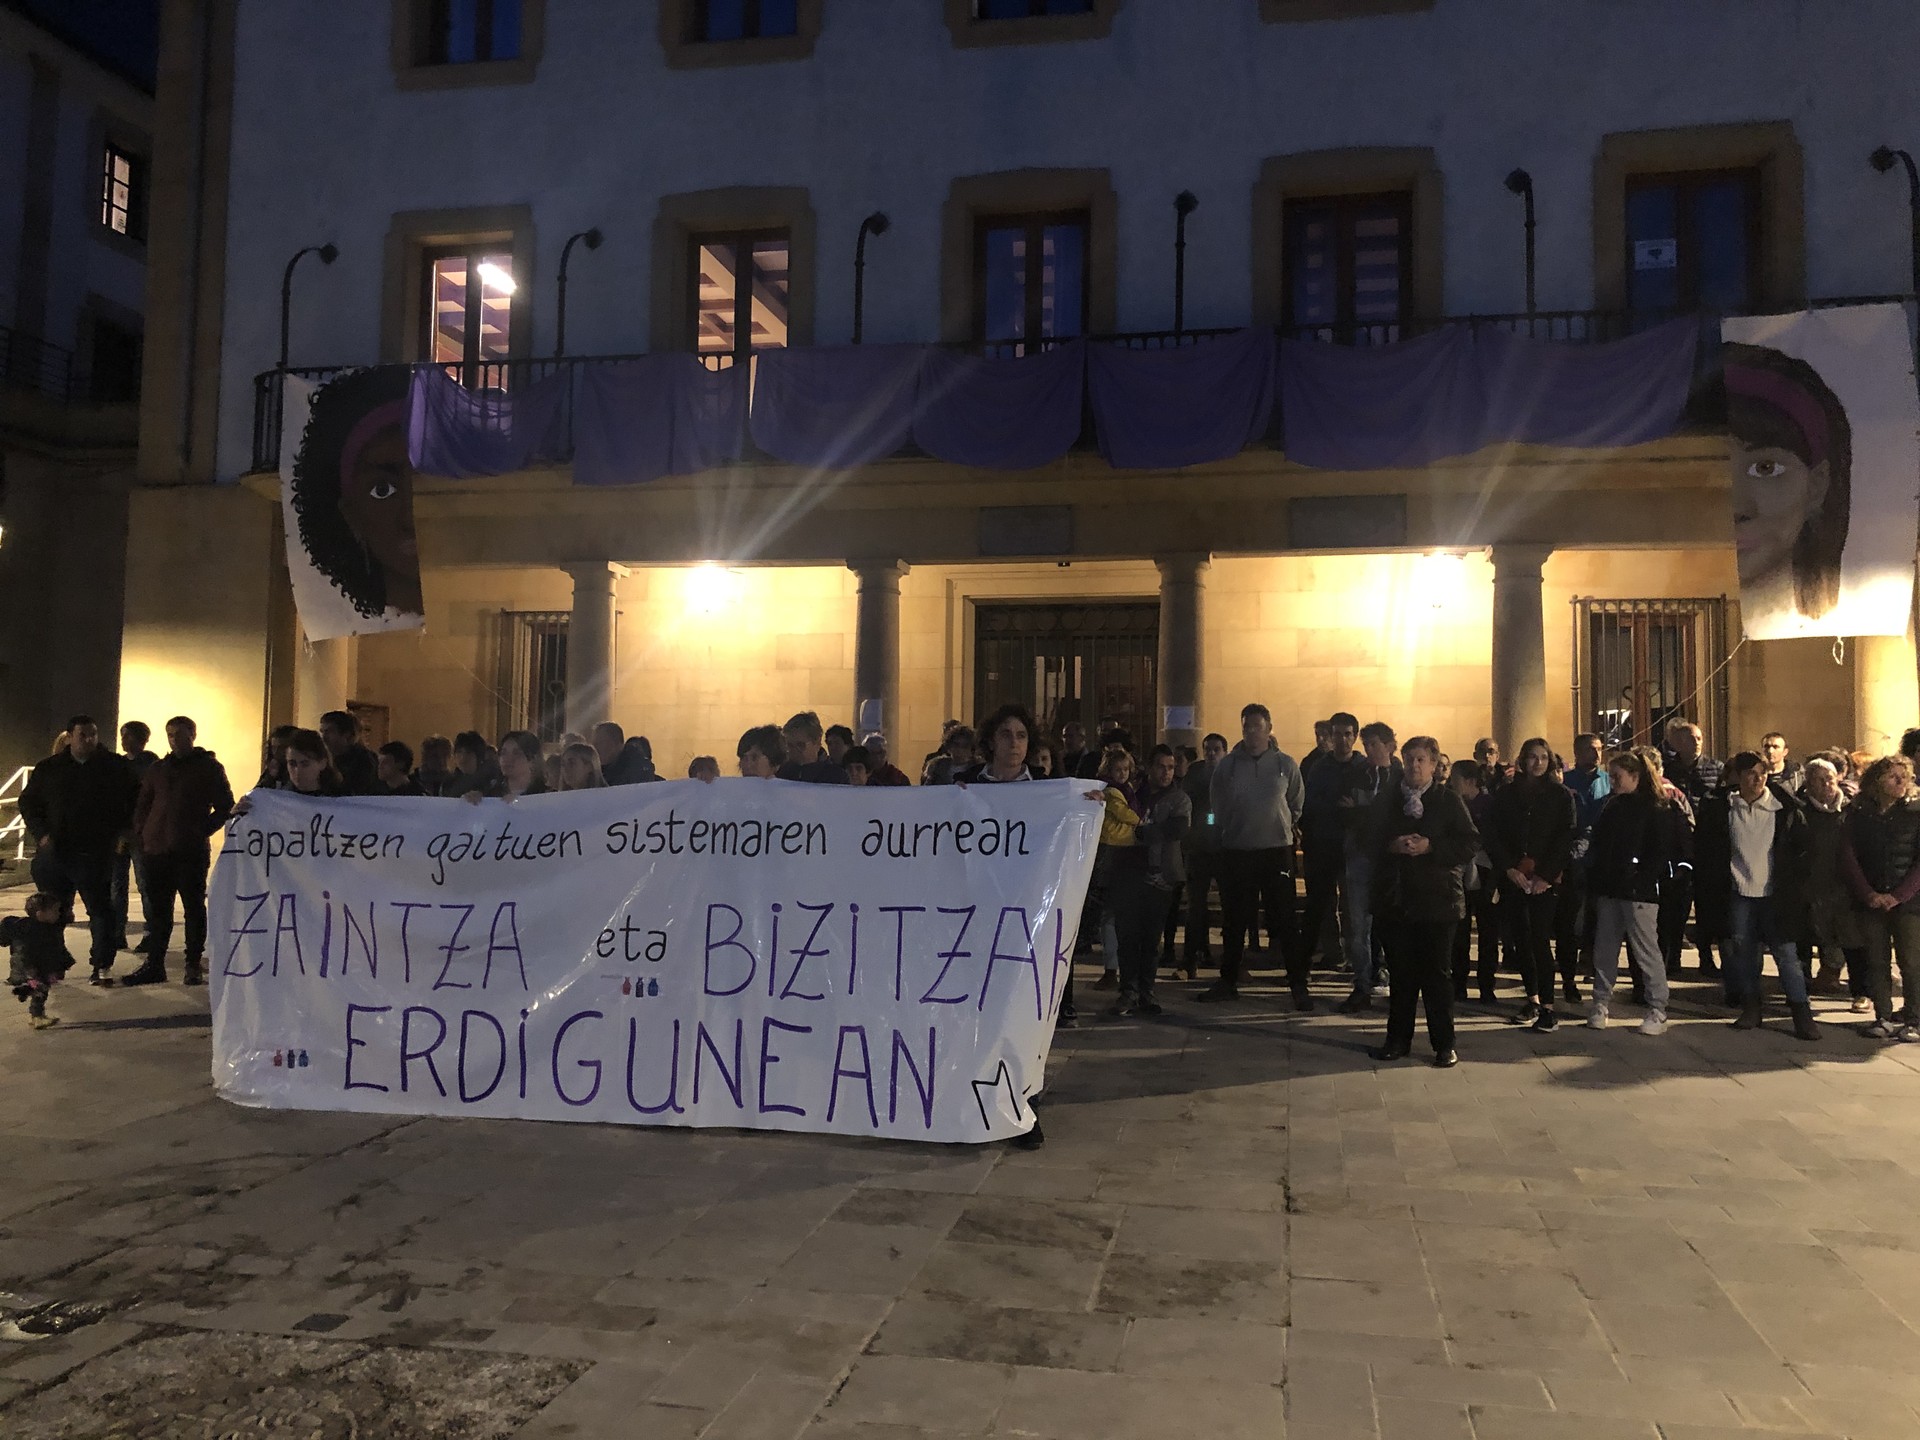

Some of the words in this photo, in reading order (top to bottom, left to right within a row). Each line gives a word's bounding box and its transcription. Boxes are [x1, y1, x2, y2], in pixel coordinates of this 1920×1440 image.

[427, 821, 582, 885] gaituen
[606, 810, 828, 856] sistemaren
[861, 819, 1030, 857] aurrean
[596, 914, 668, 962] eta
